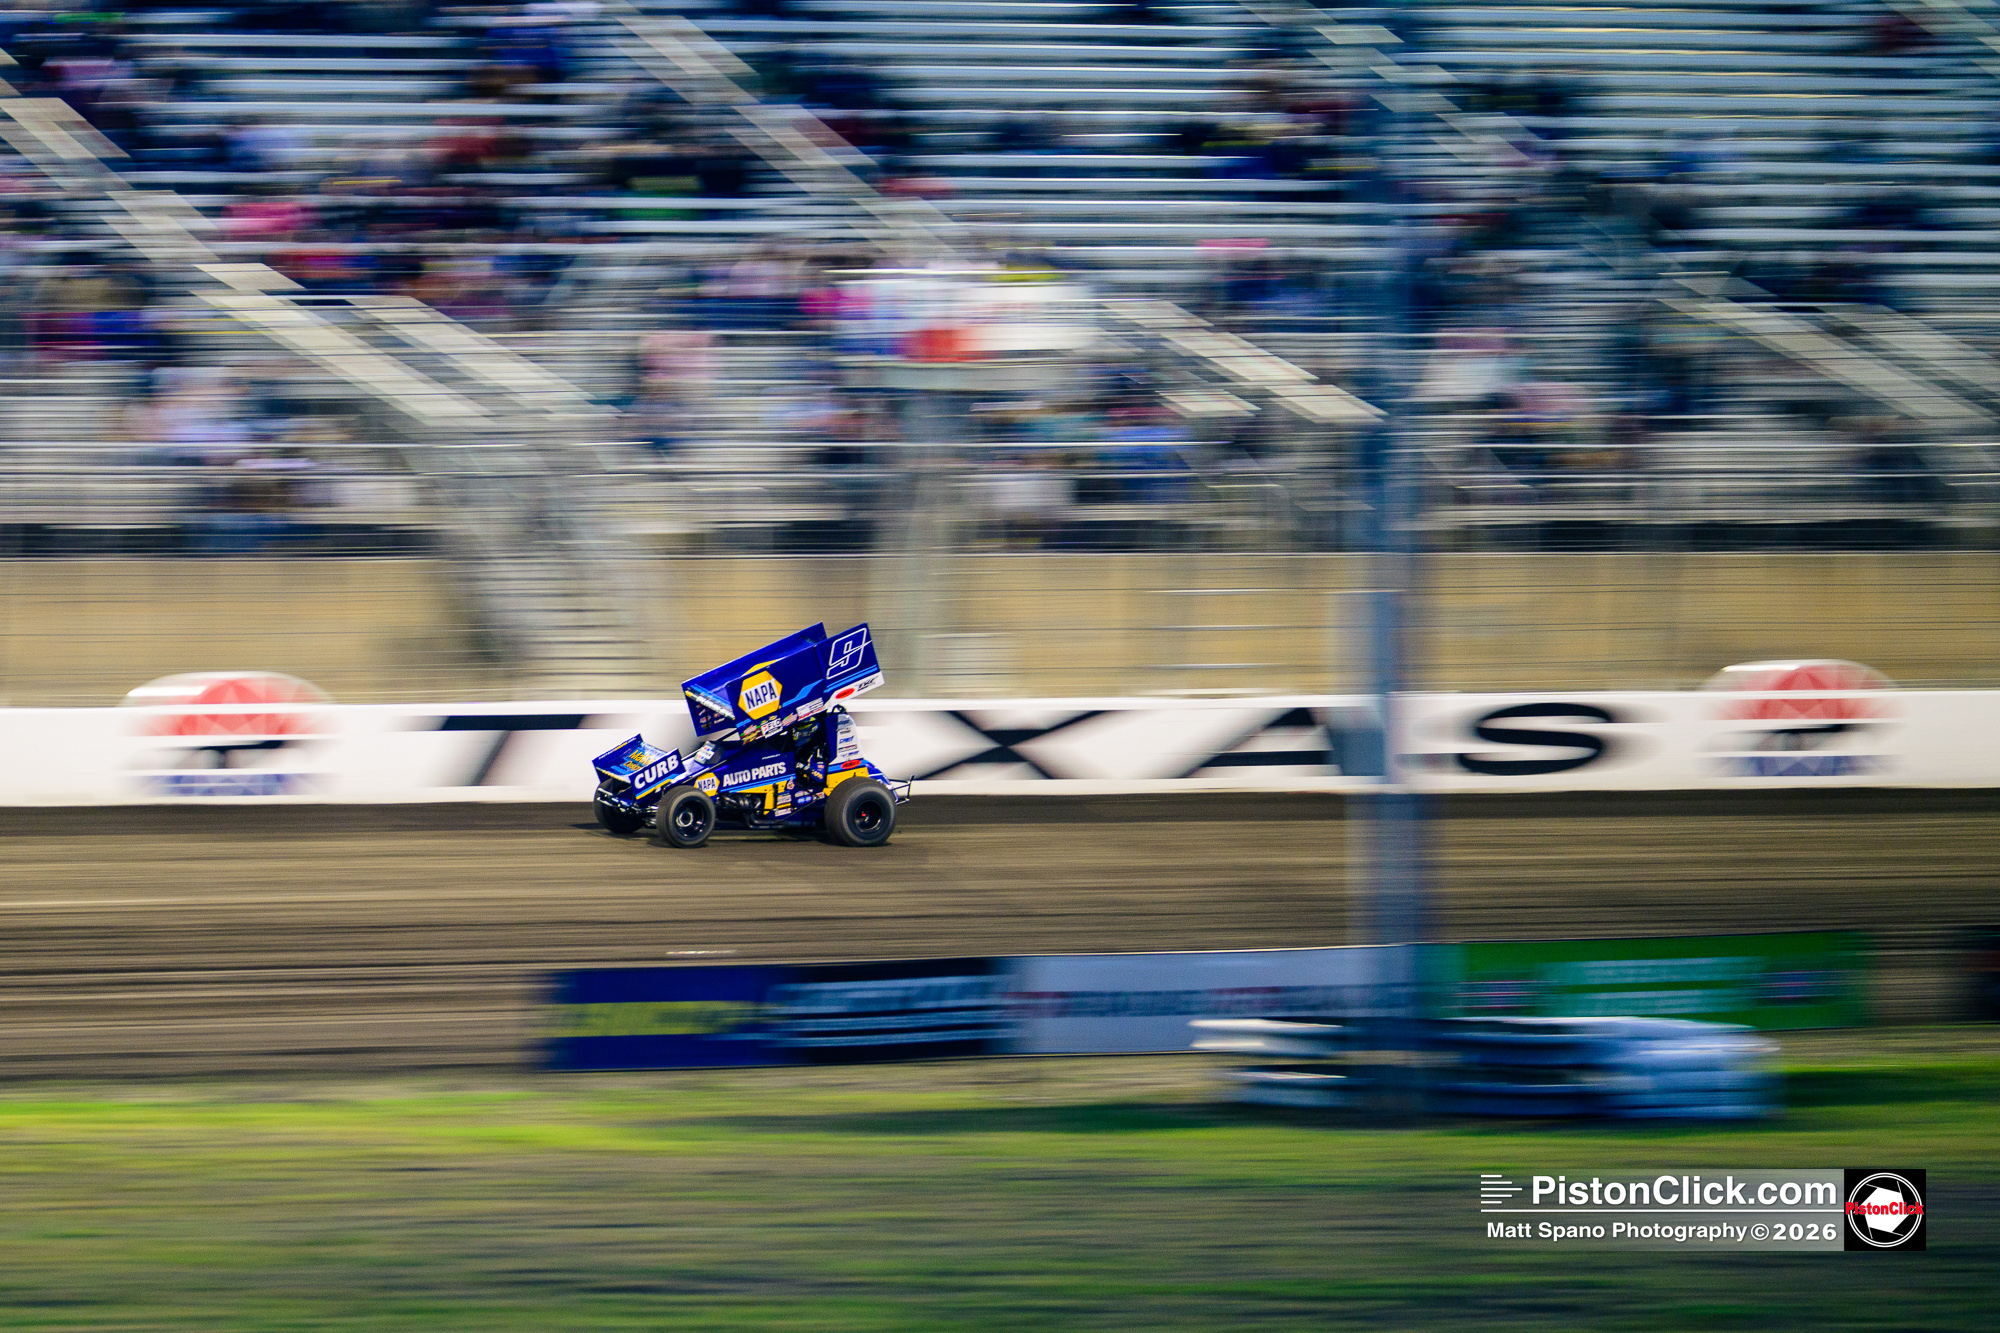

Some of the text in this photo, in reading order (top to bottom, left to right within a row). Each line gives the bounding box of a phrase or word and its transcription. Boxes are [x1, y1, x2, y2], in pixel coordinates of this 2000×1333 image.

[826, 628, 867, 680] 9
[745, 682, 777, 709] NAPA
[410, 703, 1612, 790] TXAS
[634, 754, 679, 789] CURB
[697, 778, 716, 791] NAPA
[723, 762, 786, 787] AUTO PARTS
